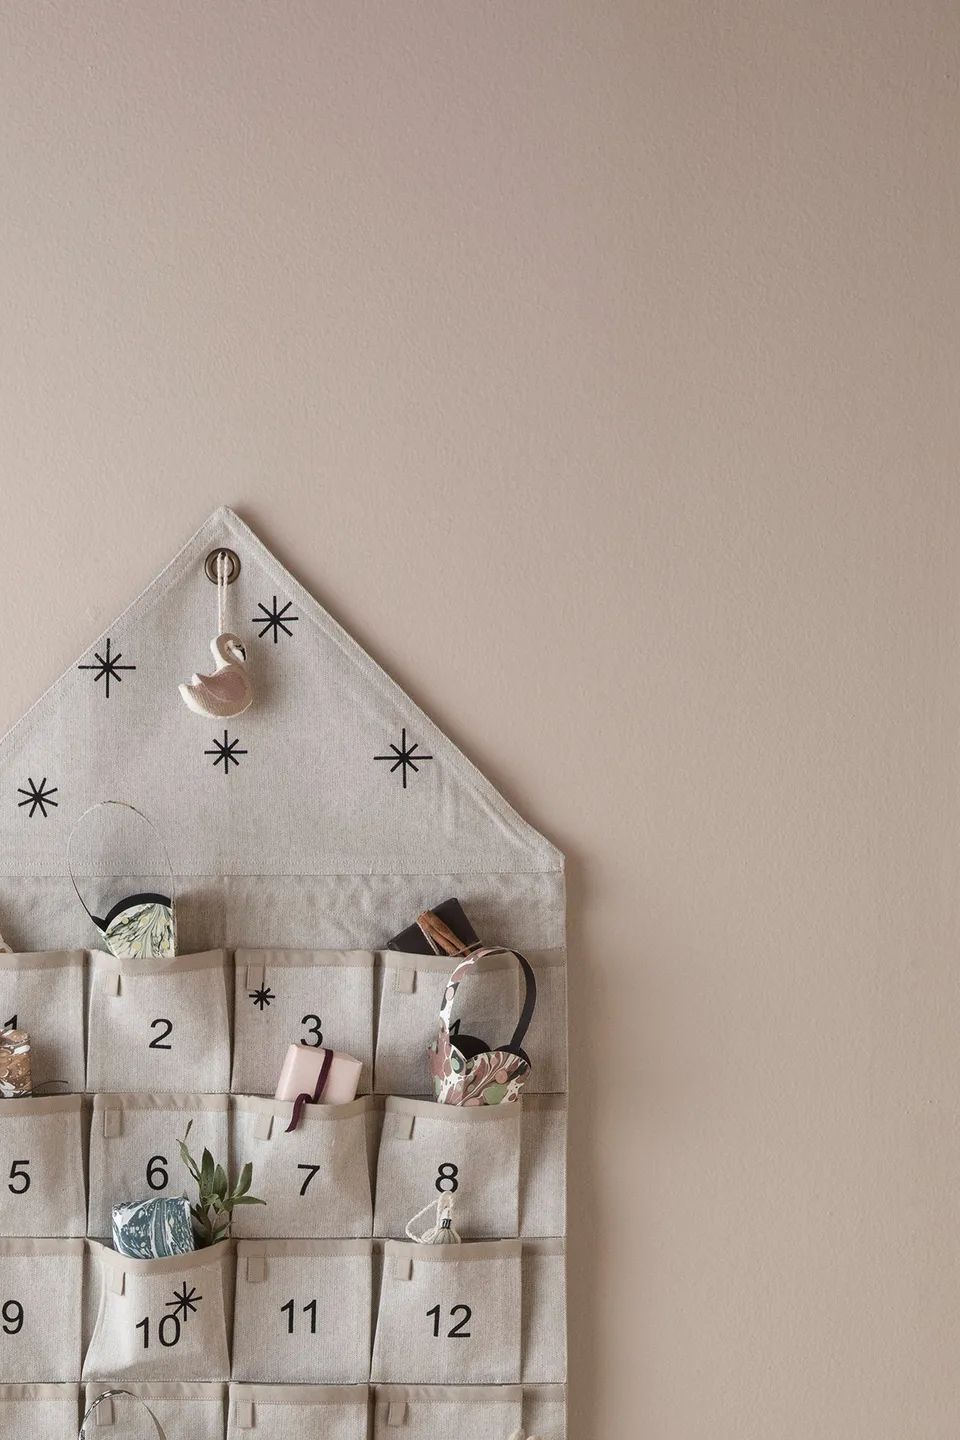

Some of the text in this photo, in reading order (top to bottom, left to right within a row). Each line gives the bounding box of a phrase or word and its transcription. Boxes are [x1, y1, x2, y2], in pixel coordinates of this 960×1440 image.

[148, 1018, 173, 1050] 2
[300, 1014, 323, 1049] 3
[8, 1159, 31, 1195] 5
[146, 1155, 169, 1191] 6
[297, 1163, 321, 1196] 7
[435, 1162, 459, 1195] 8
[1, 1299, 24, 1335] 9
[134, 1313, 182, 1350] 10
[280, 1298, 317, 1334] 11
[426, 1304, 472, 1338] 12
